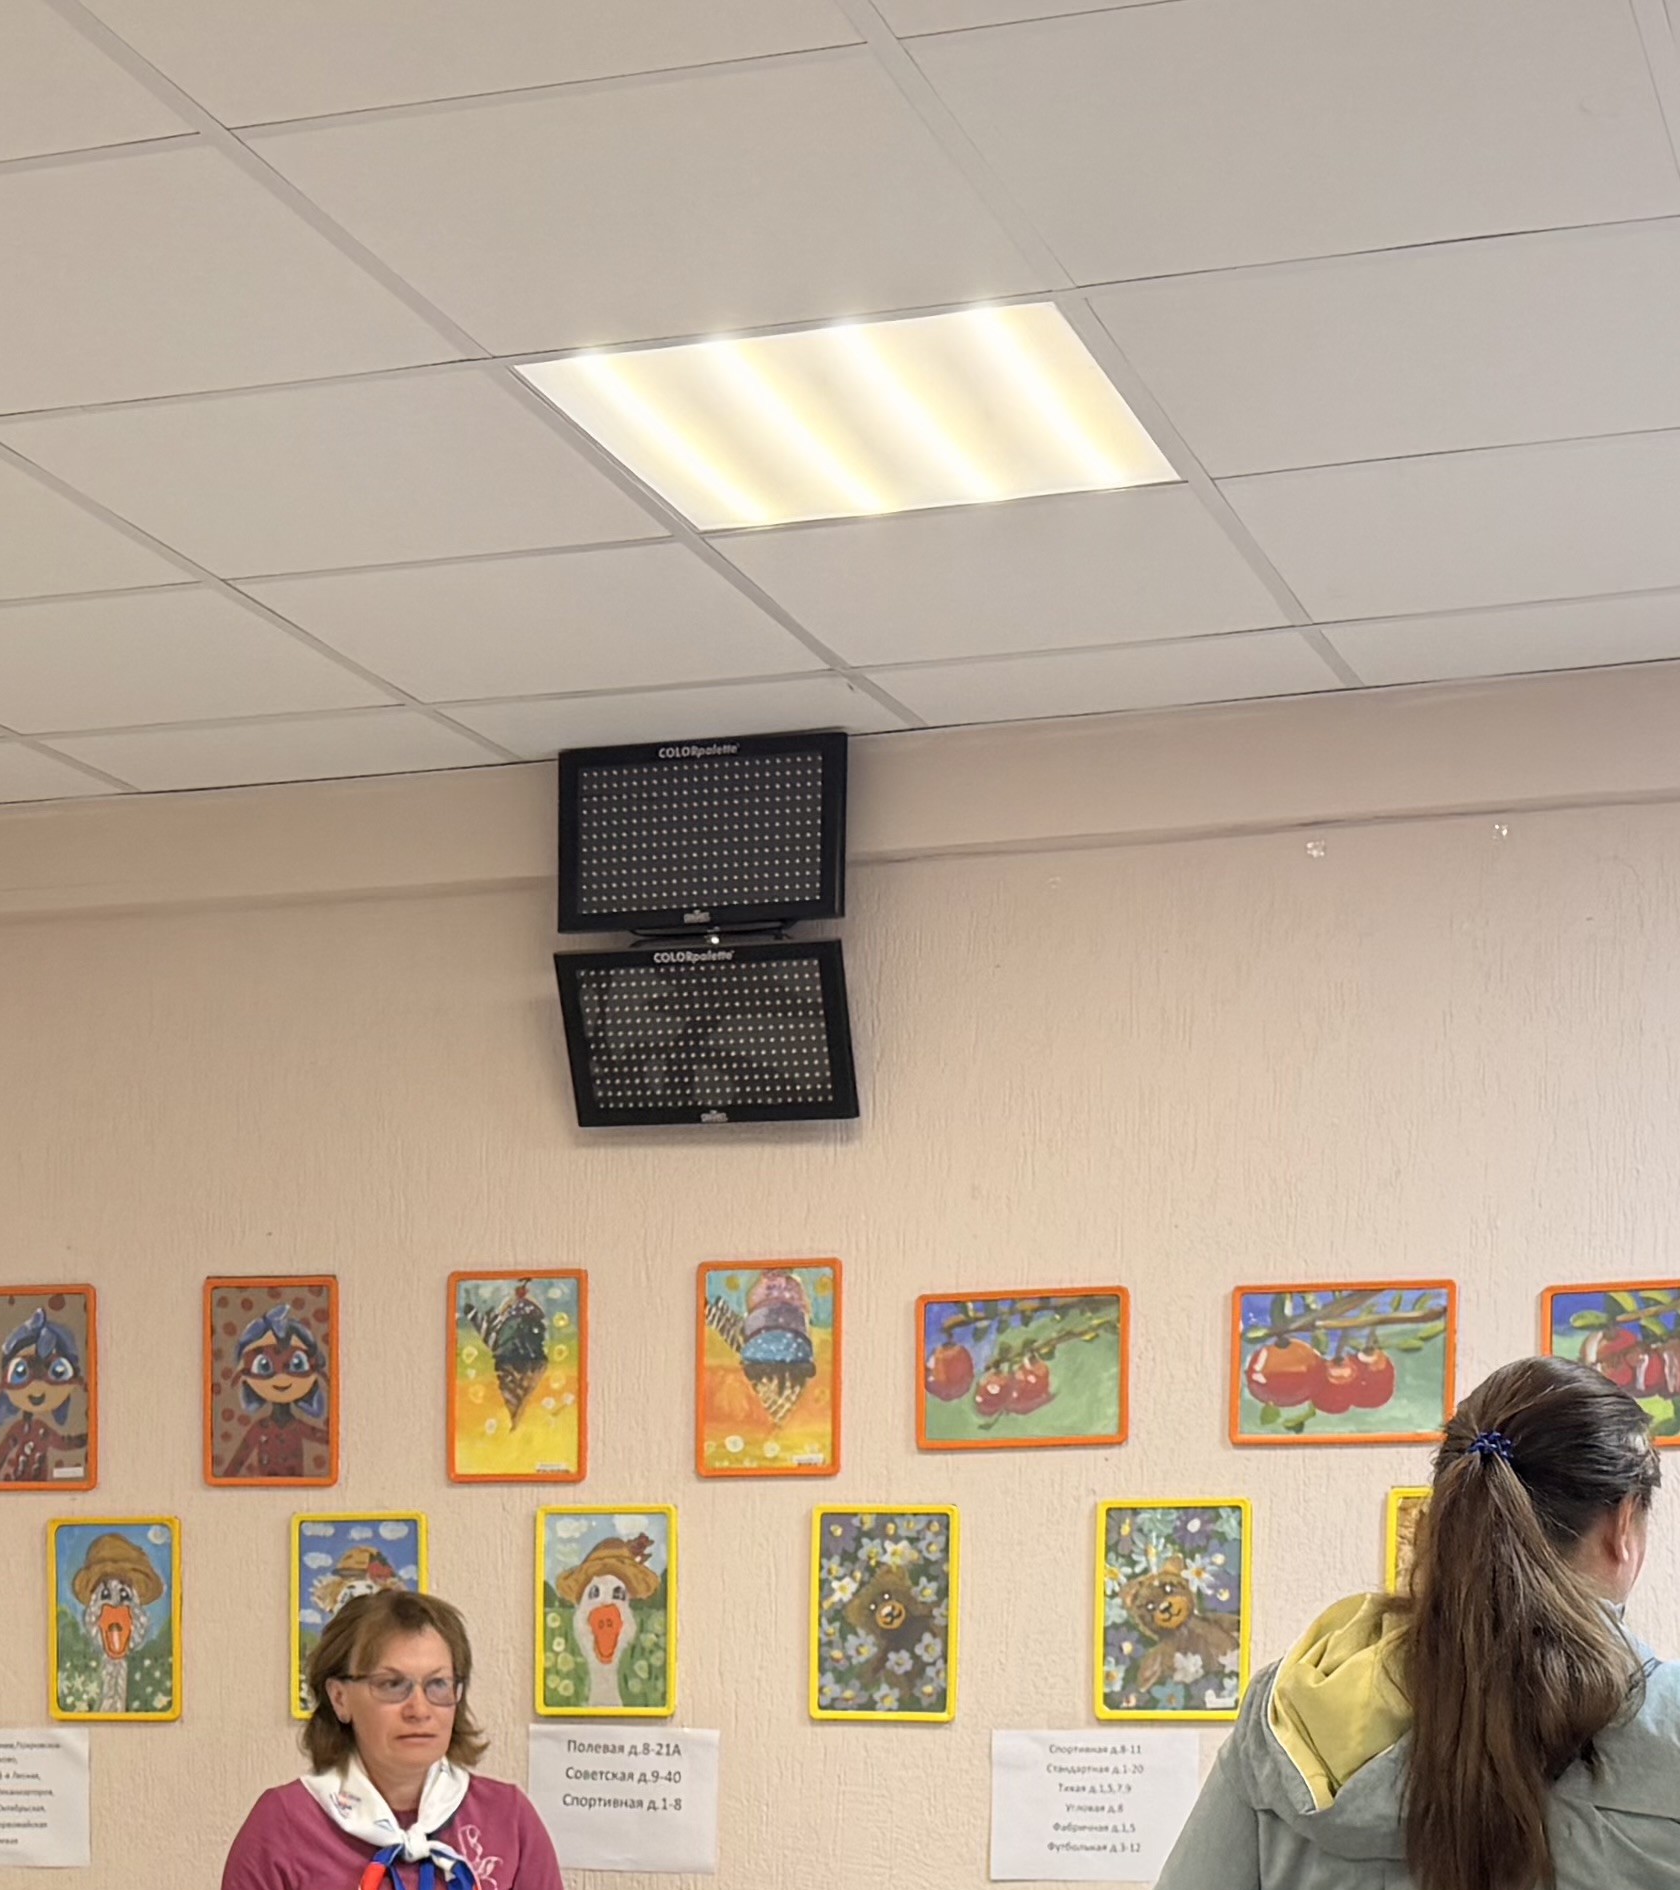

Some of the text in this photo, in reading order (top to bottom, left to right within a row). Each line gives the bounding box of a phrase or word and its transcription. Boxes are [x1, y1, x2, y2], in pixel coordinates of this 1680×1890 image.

[567, 1739, 682, 1757] Полевая д.8-21А
[565, 1766, 682, 1784] Советская д.9-40
[562, 1793, 682, 1812] Спортивная д.1-8
